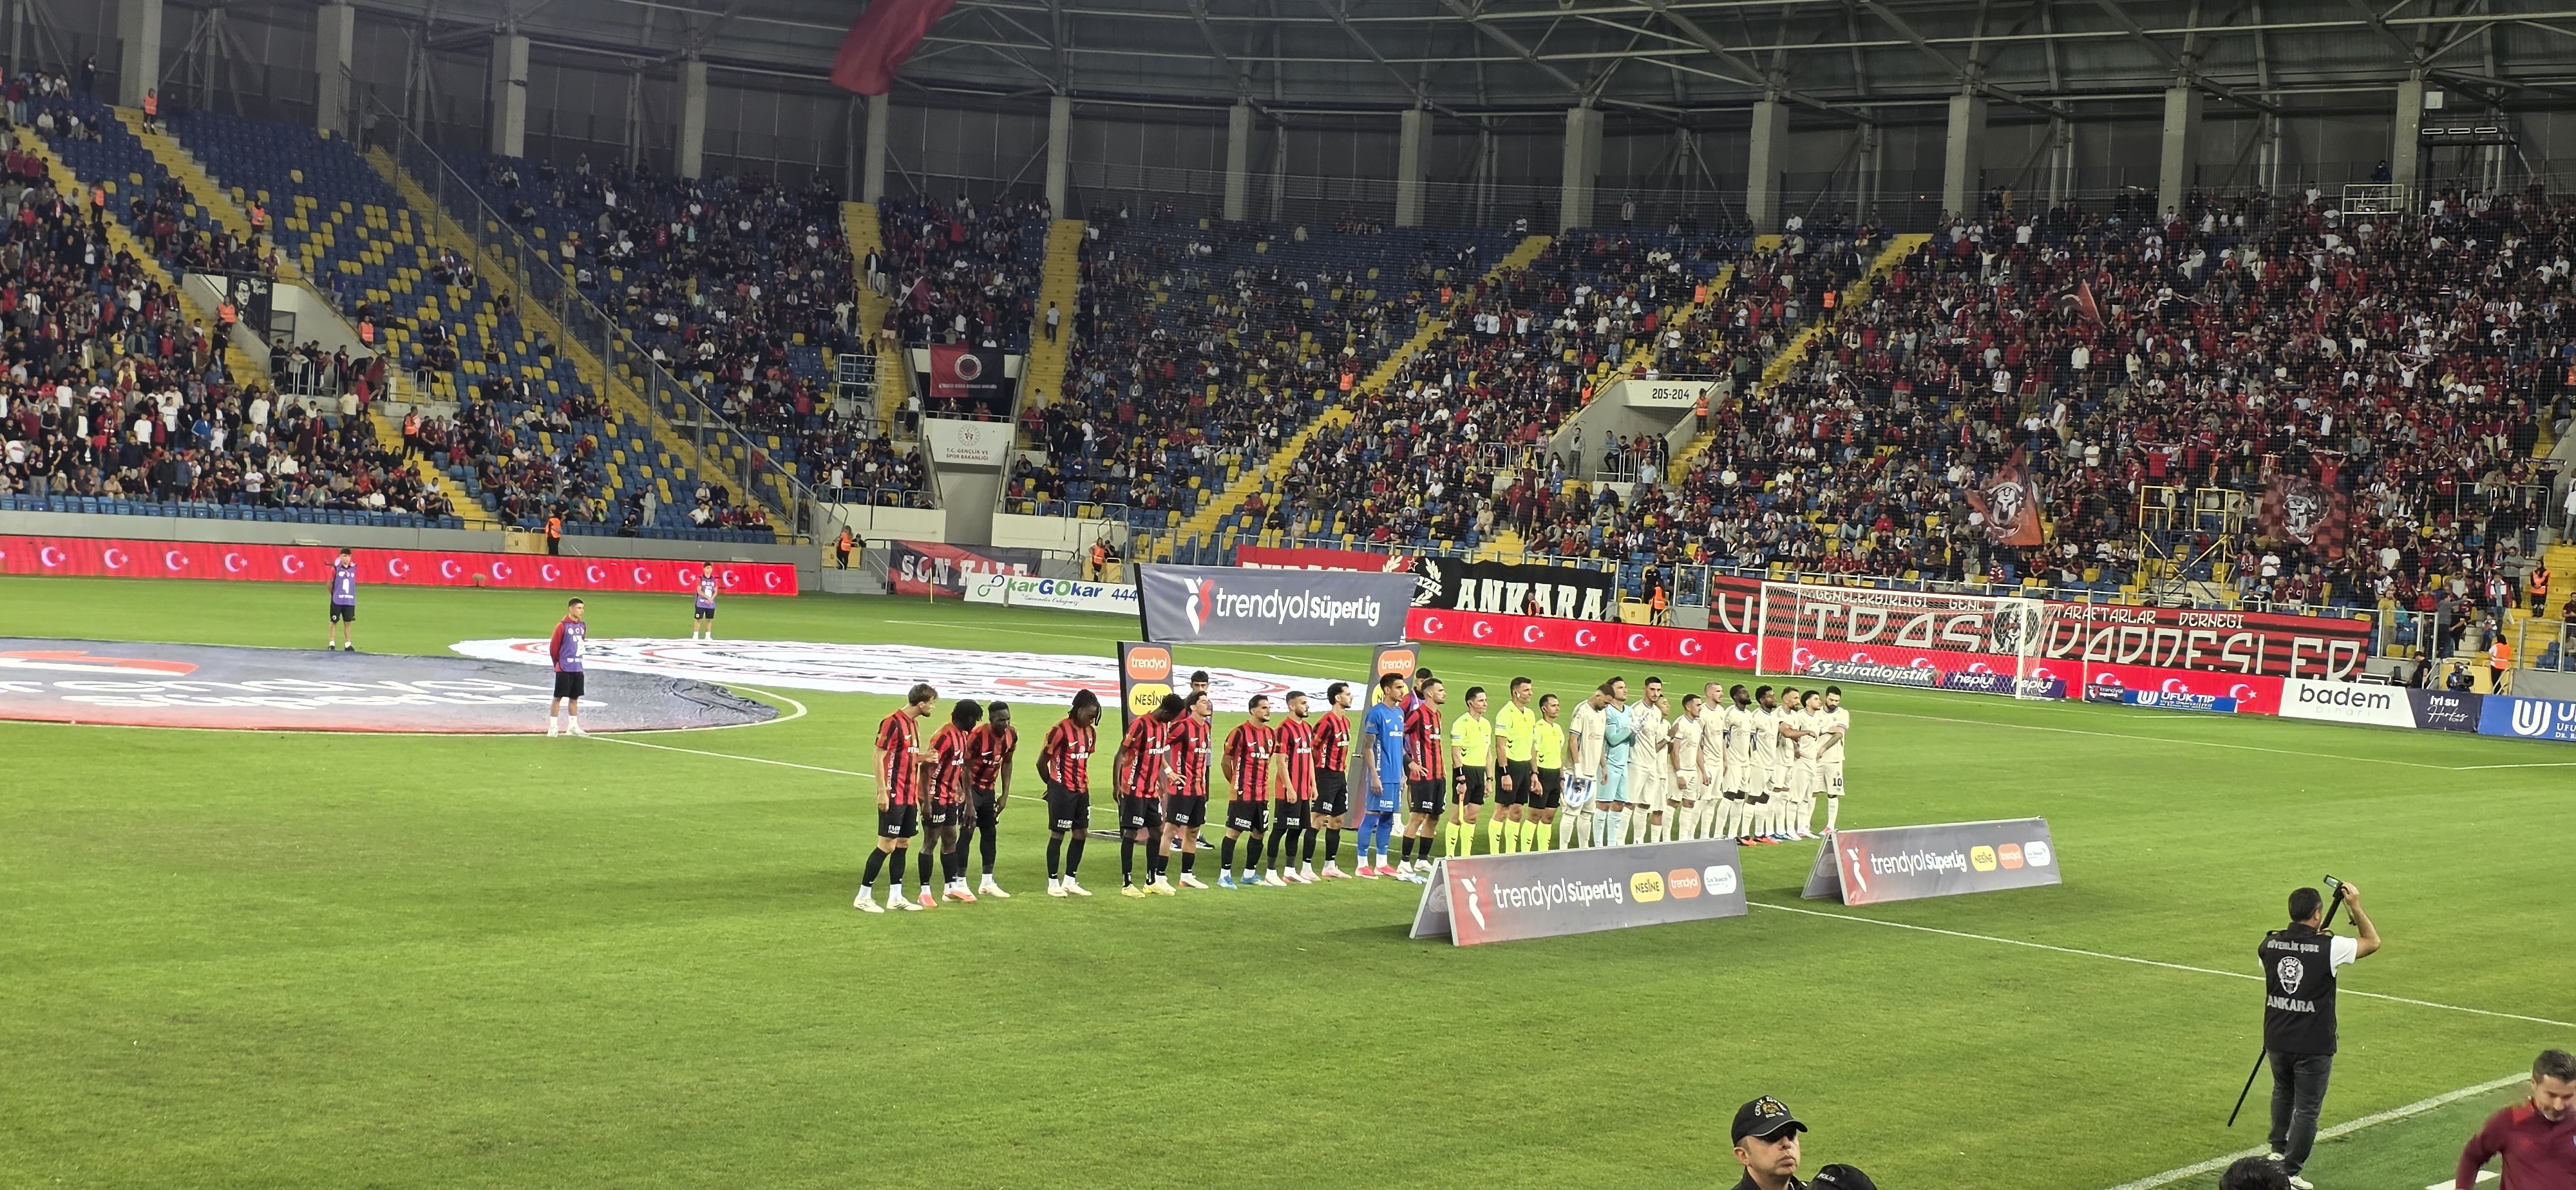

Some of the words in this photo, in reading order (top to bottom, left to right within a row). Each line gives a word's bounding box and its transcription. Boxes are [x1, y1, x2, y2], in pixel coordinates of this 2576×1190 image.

[1652, 388, 1690, 401] 205-204
[901, 555, 951, 585] SON
[1007, 578, 1103, 598] karGOkar
[1111, 588, 1137, 601] 444
[1216, 587, 1309, 624] trendyol
[1453, 578, 1602, 621] ANKARA
[1131, 656, 1167, 671] trendyol
[1381, 657, 1412, 670] trendyol
[0, 678, 555, 694] rendyol
[2161, 691, 2195, 702] UFUK
[2196, 694, 2215, 703] TIP
[2299, 684, 2391, 710] badem
[2557, 703, 2576, 722] U
[1833, 777, 1842, 786] 10
[1870, 849, 1927, 876] trendyol
[1493, 878, 1568, 911] trendyol
[1671, 876, 1699, 890] trendyol
[2267, 994, 2316, 1012] ANKARA
